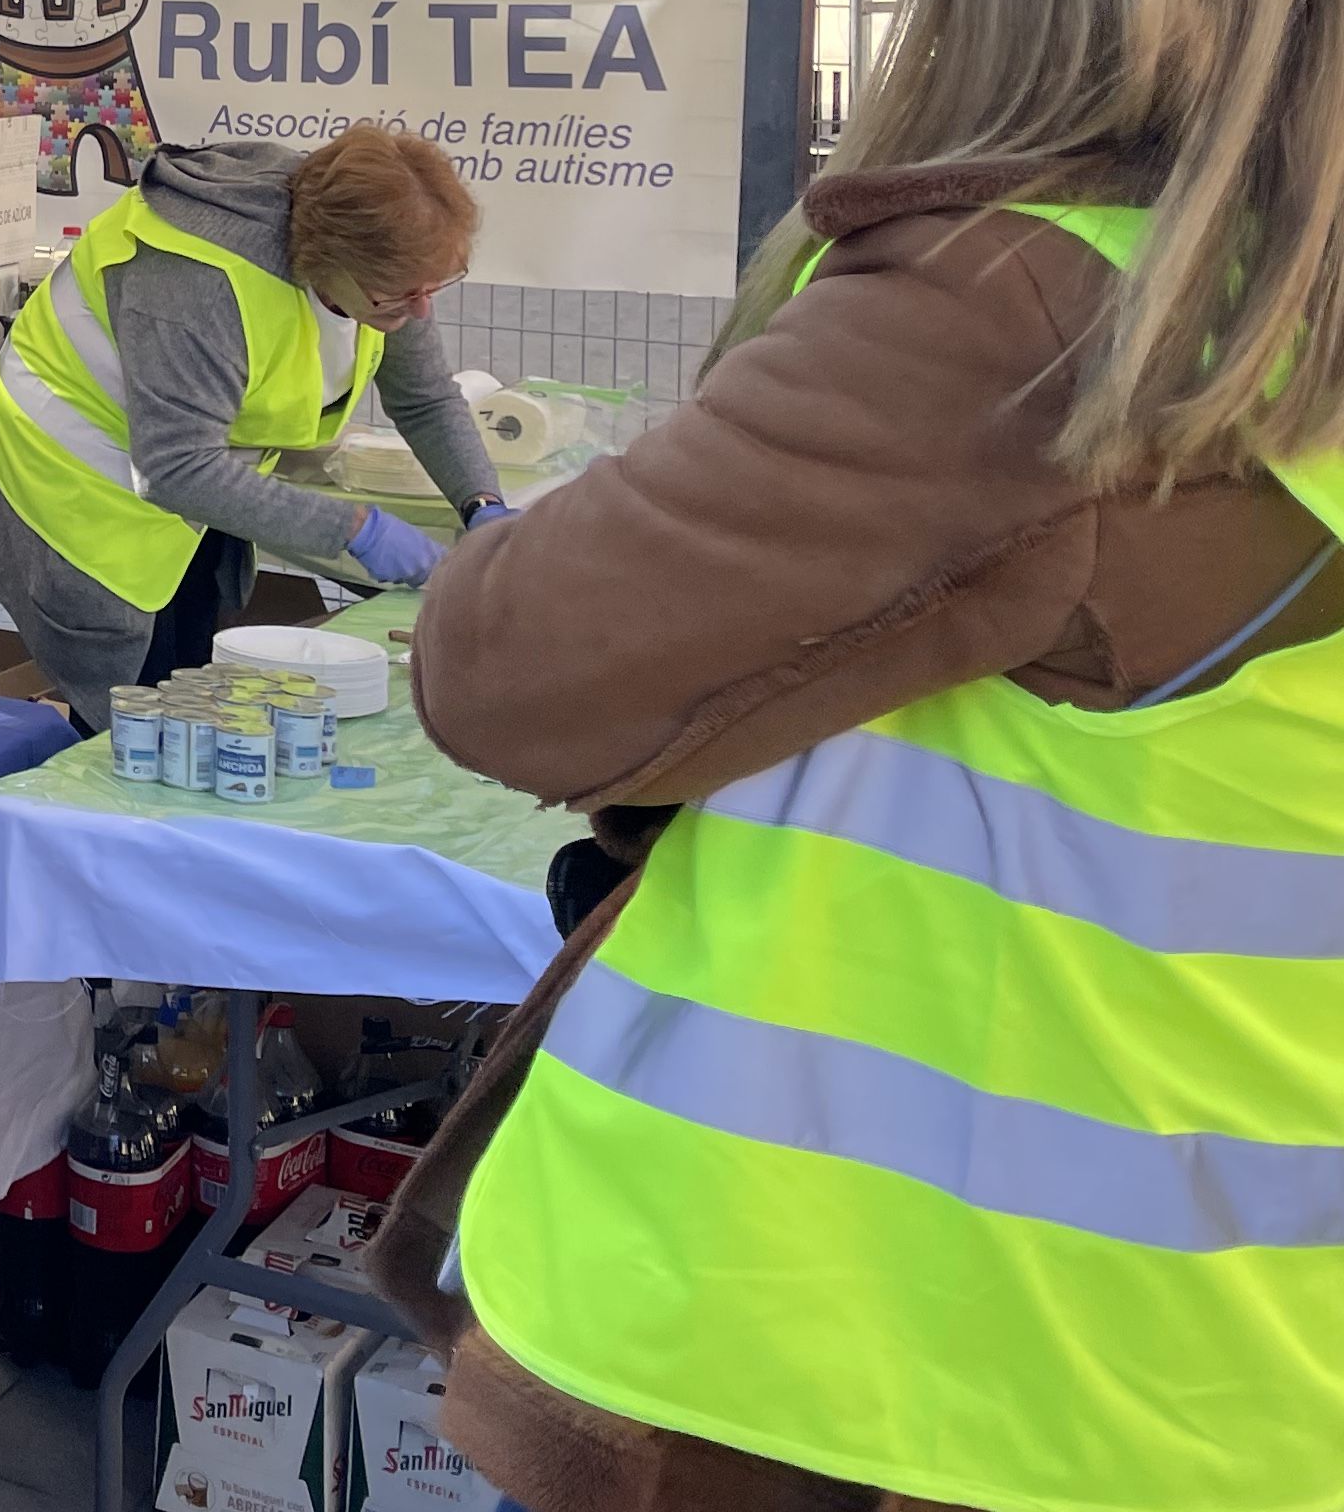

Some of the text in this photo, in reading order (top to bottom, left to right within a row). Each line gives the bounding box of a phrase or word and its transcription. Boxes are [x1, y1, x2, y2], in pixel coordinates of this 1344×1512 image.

[158, 0, 667, 92] Rubí TEA
[421, 108, 466, 145] de
[479, 115, 632, 152] famílies
[515, 152, 674, 189] autisme
[4, 210, 12, 223] DE
[213, 1425, 264, 1448] ESPECIAL
[407, 1478, 461, 1502] ESPECIAL
